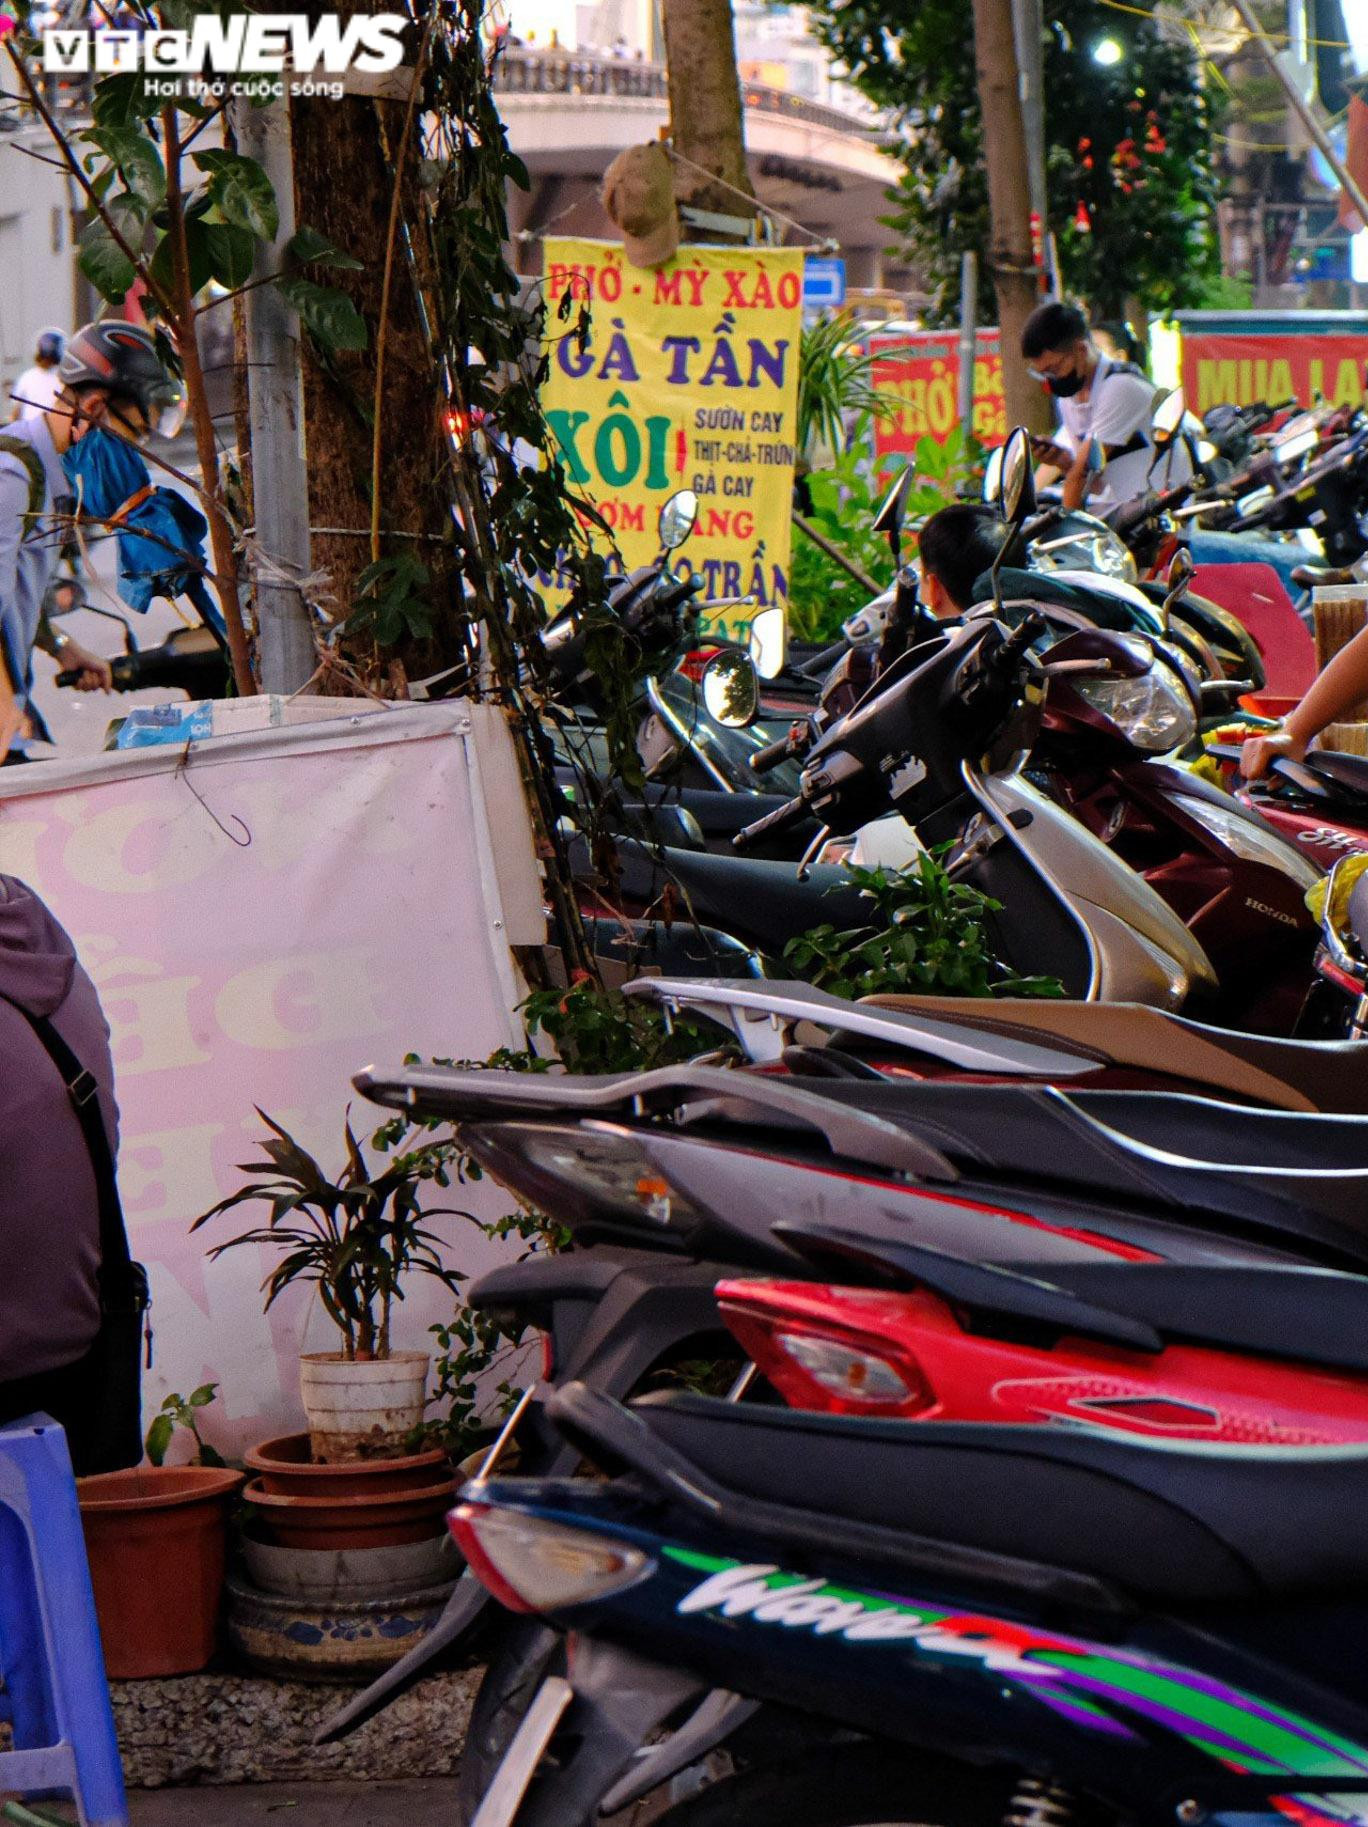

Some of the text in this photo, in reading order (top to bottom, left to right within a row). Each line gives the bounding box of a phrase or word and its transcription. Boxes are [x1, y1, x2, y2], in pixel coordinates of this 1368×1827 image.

[722, 261, 800, 309] XÀO
[557, 312, 789, 388] GÀ TẦN
[1198, 359, 1294, 411] MUA
[546, 390, 671, 488] XÔI
[695, 405, 784, 432] SƯỜN CAY
[693, 469, 754, 497] GÀ CAY
[1245, 897, 1298, 928] HONDA
